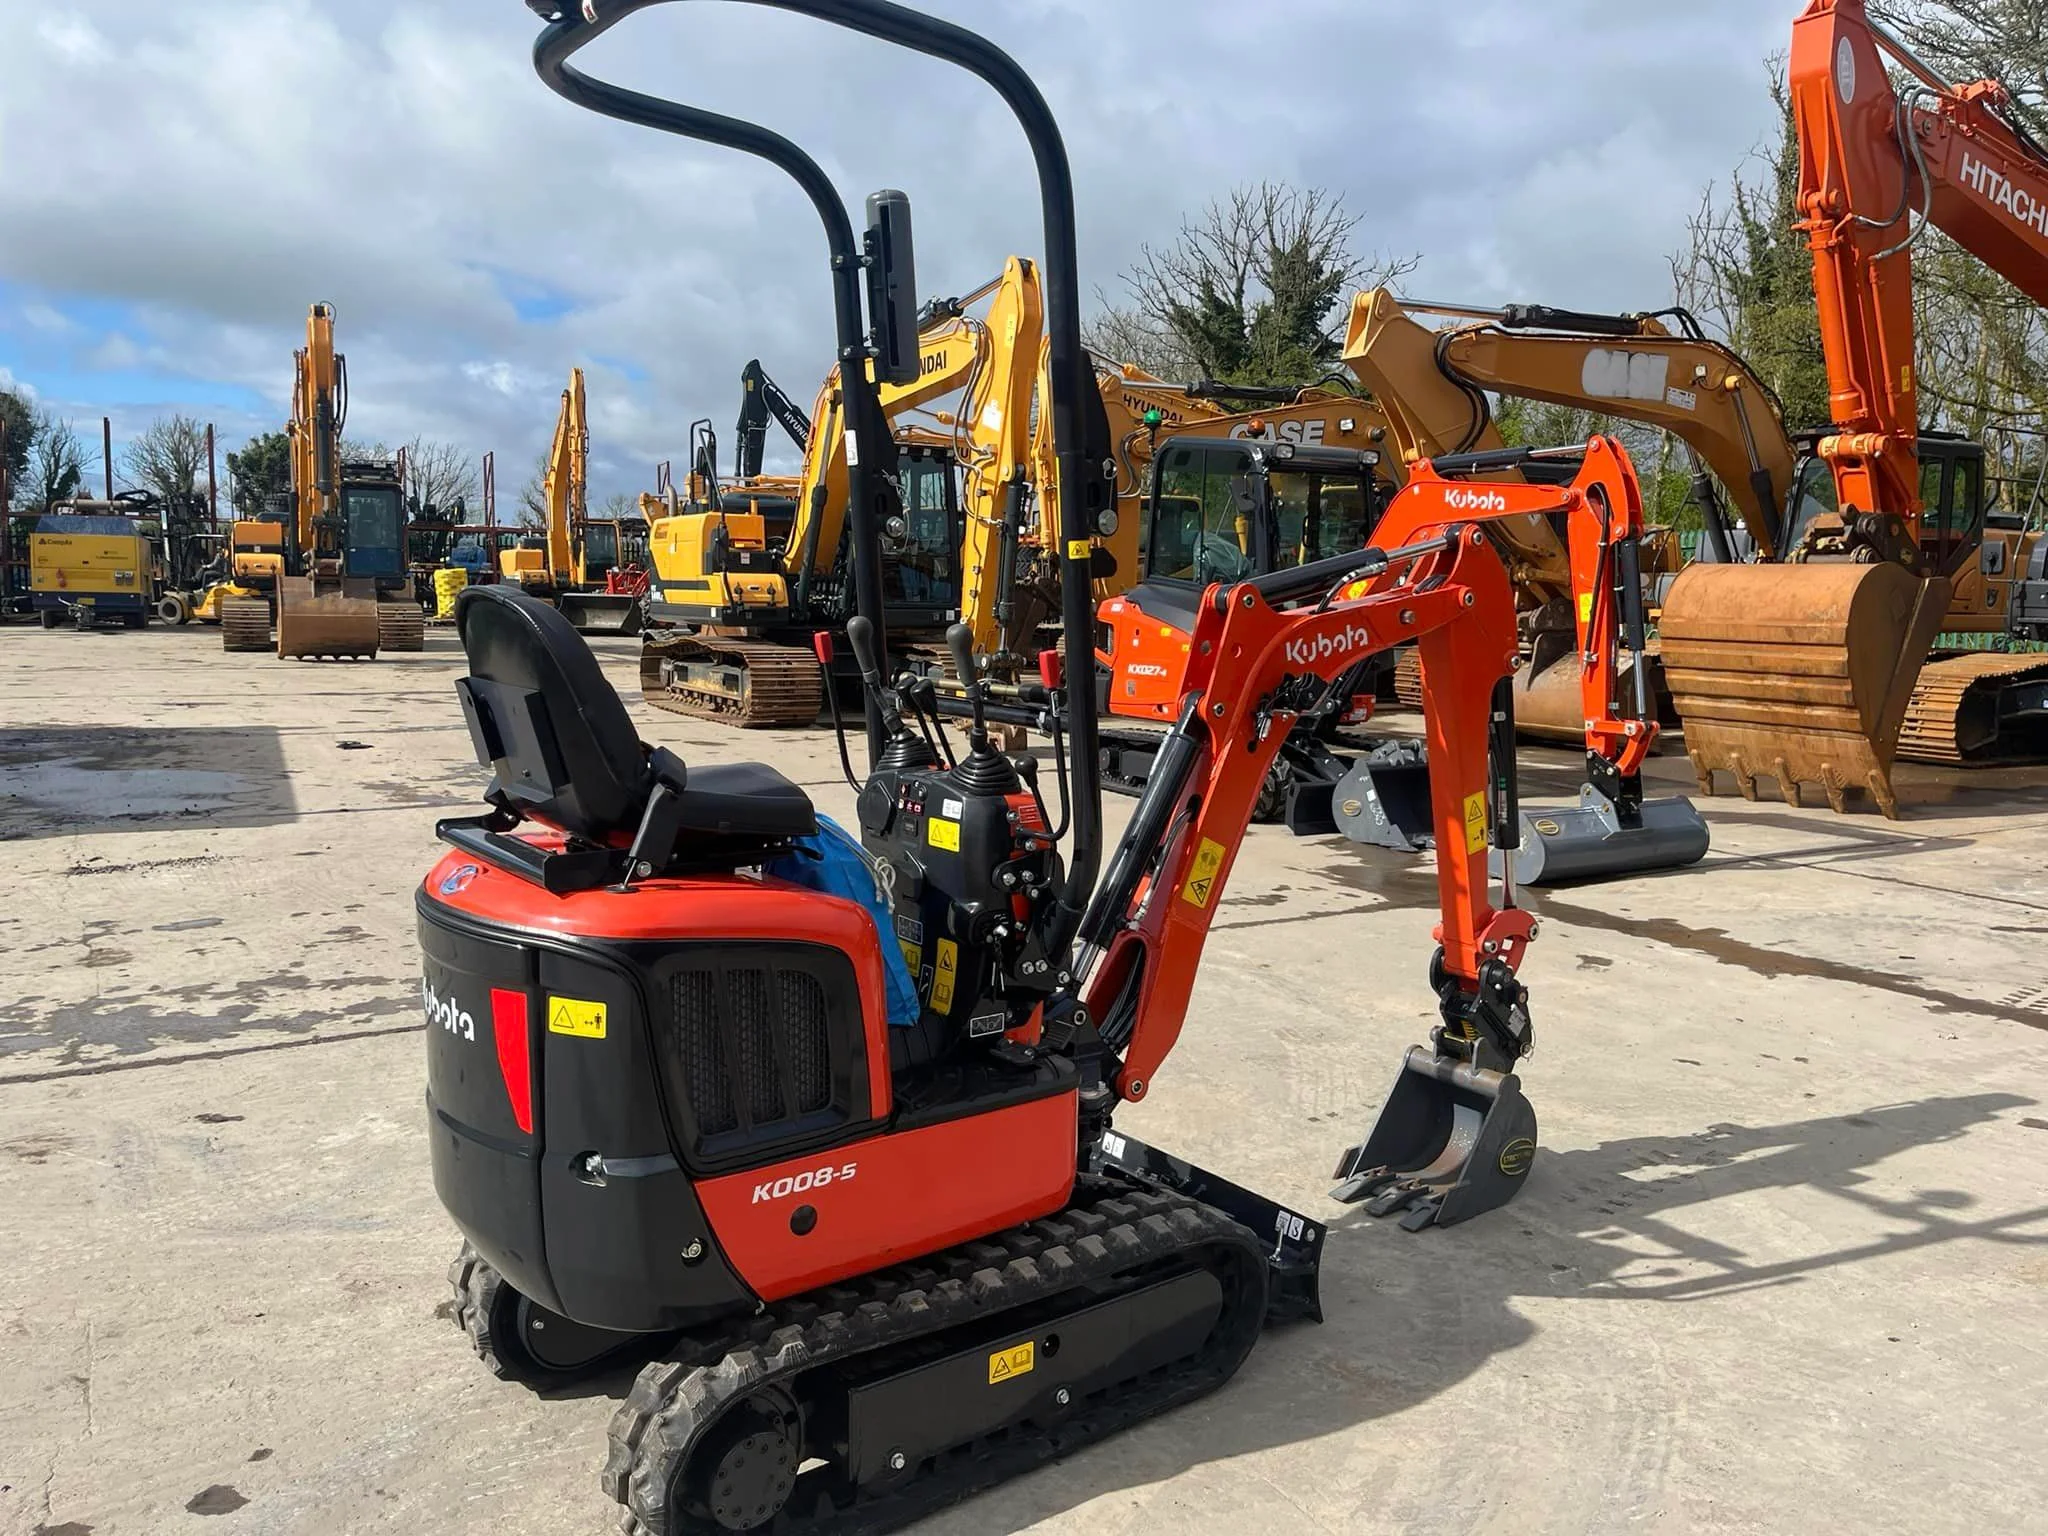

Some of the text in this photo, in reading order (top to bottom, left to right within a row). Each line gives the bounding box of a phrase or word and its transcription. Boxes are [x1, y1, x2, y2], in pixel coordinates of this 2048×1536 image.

[1228, 420, 1326, 446] CASE
[1444, 488, 1505, 511] Kubota
[1285, 624, 1369, 665] Kubota
[751, 1162, 858, 1205] K008-5
